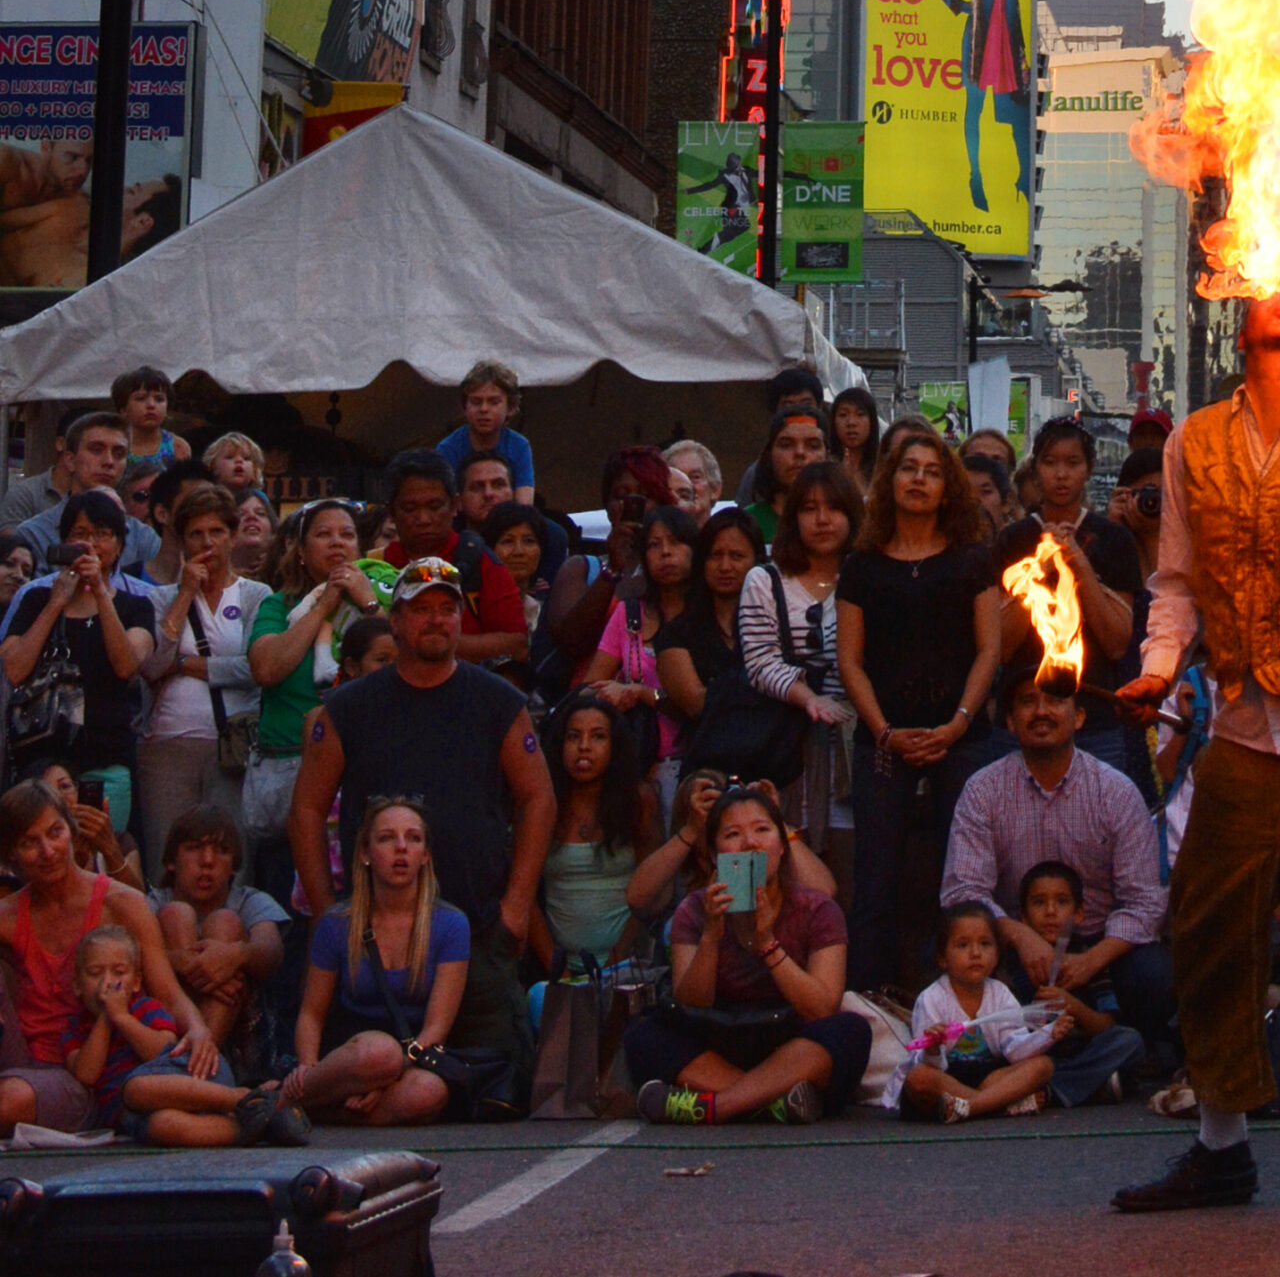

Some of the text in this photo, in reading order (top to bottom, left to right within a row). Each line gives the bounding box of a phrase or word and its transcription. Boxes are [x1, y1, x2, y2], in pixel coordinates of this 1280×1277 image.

[880, 8, 919, 26] what
[894, 30, 928, 49] you
[871, 44, 967, 91] love
[11, 79, 72, 95] LUXURY
[899, 108, 958, 122] HUMBER
[14, 125, 93, 142] QUADRO
[684, 120, 755, 147] LIVE
